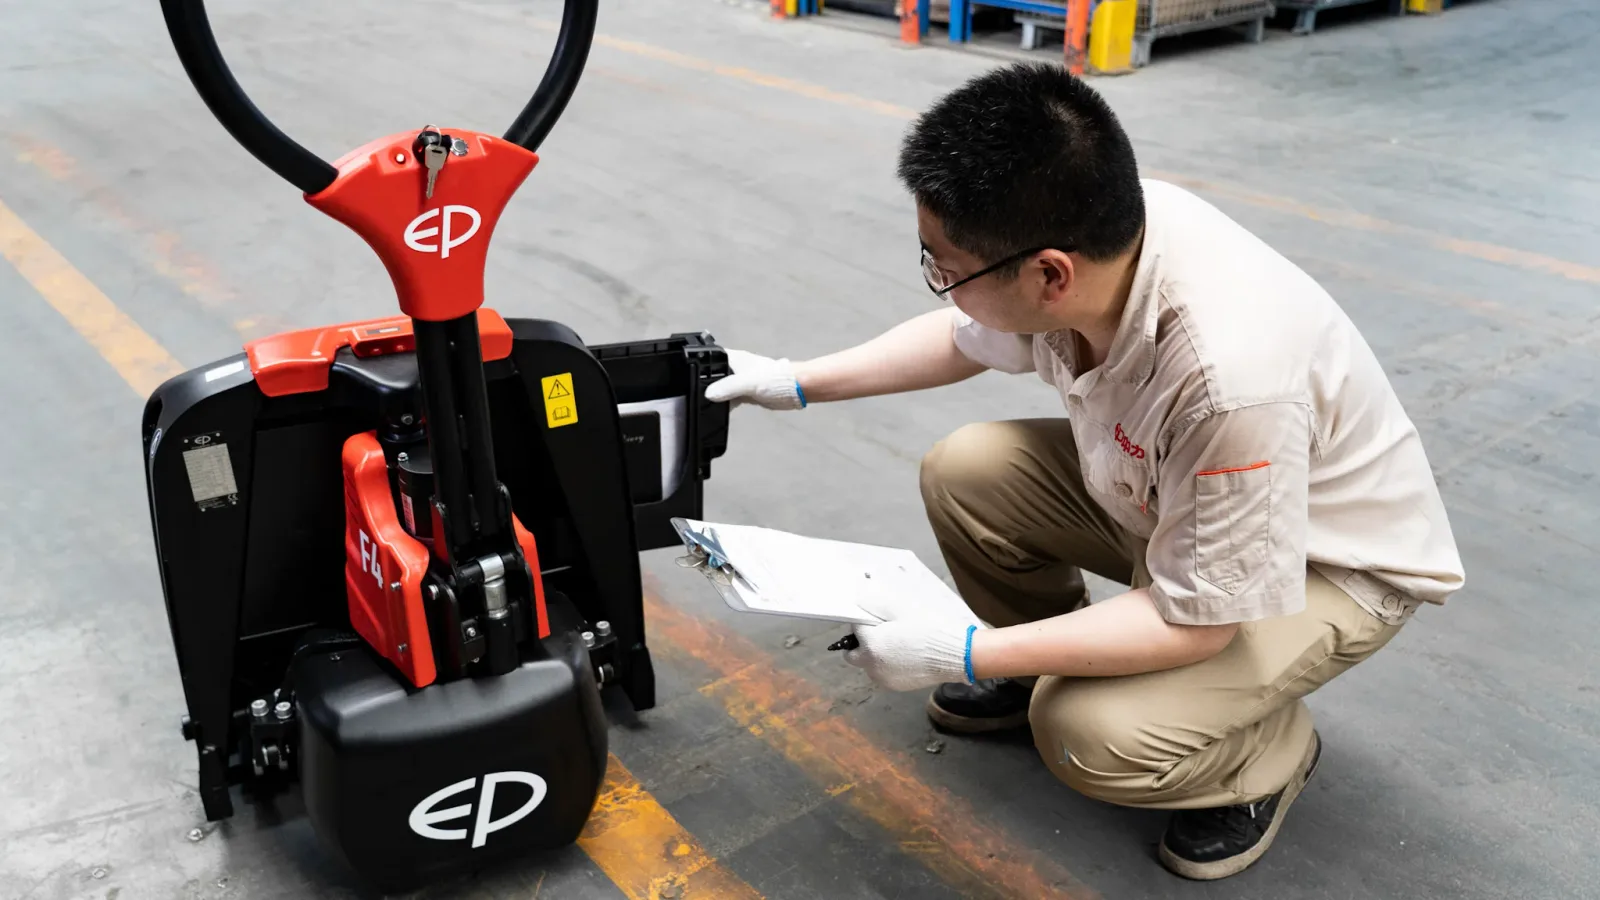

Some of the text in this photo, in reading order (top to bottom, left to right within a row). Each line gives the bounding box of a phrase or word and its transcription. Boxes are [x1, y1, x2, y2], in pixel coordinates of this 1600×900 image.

[404, 205, 481, 259] EP
[194, 435, 212, 446] EP
[359, 528, 384, 589] F4
[408, 771, 548, 849] EP
